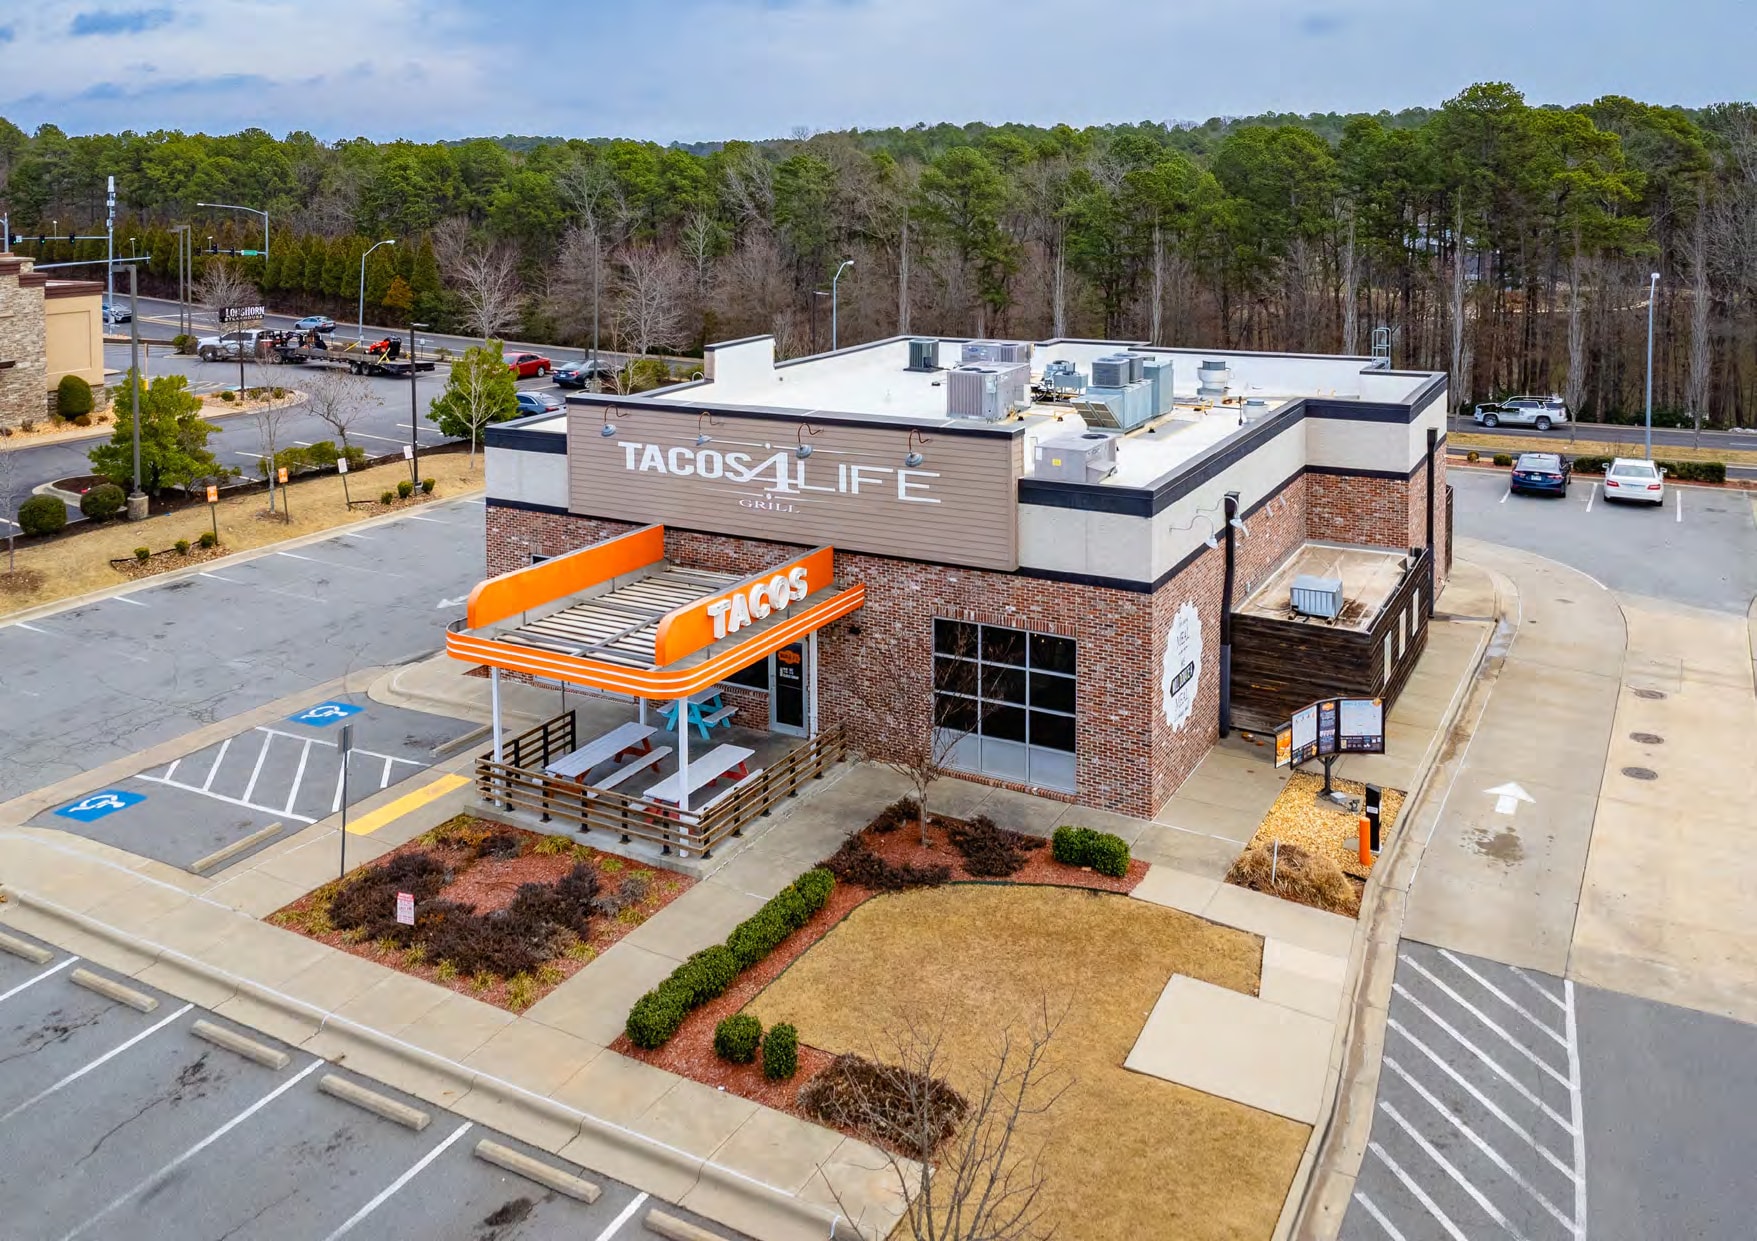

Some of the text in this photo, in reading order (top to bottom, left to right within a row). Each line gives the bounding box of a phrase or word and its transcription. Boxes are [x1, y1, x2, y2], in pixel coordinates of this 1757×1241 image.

[617, 441, 941, 504] TACOS 4 LIFE
[739, 499, 801, 515] GRILL
[707, 567, 808, 639] TACOS
